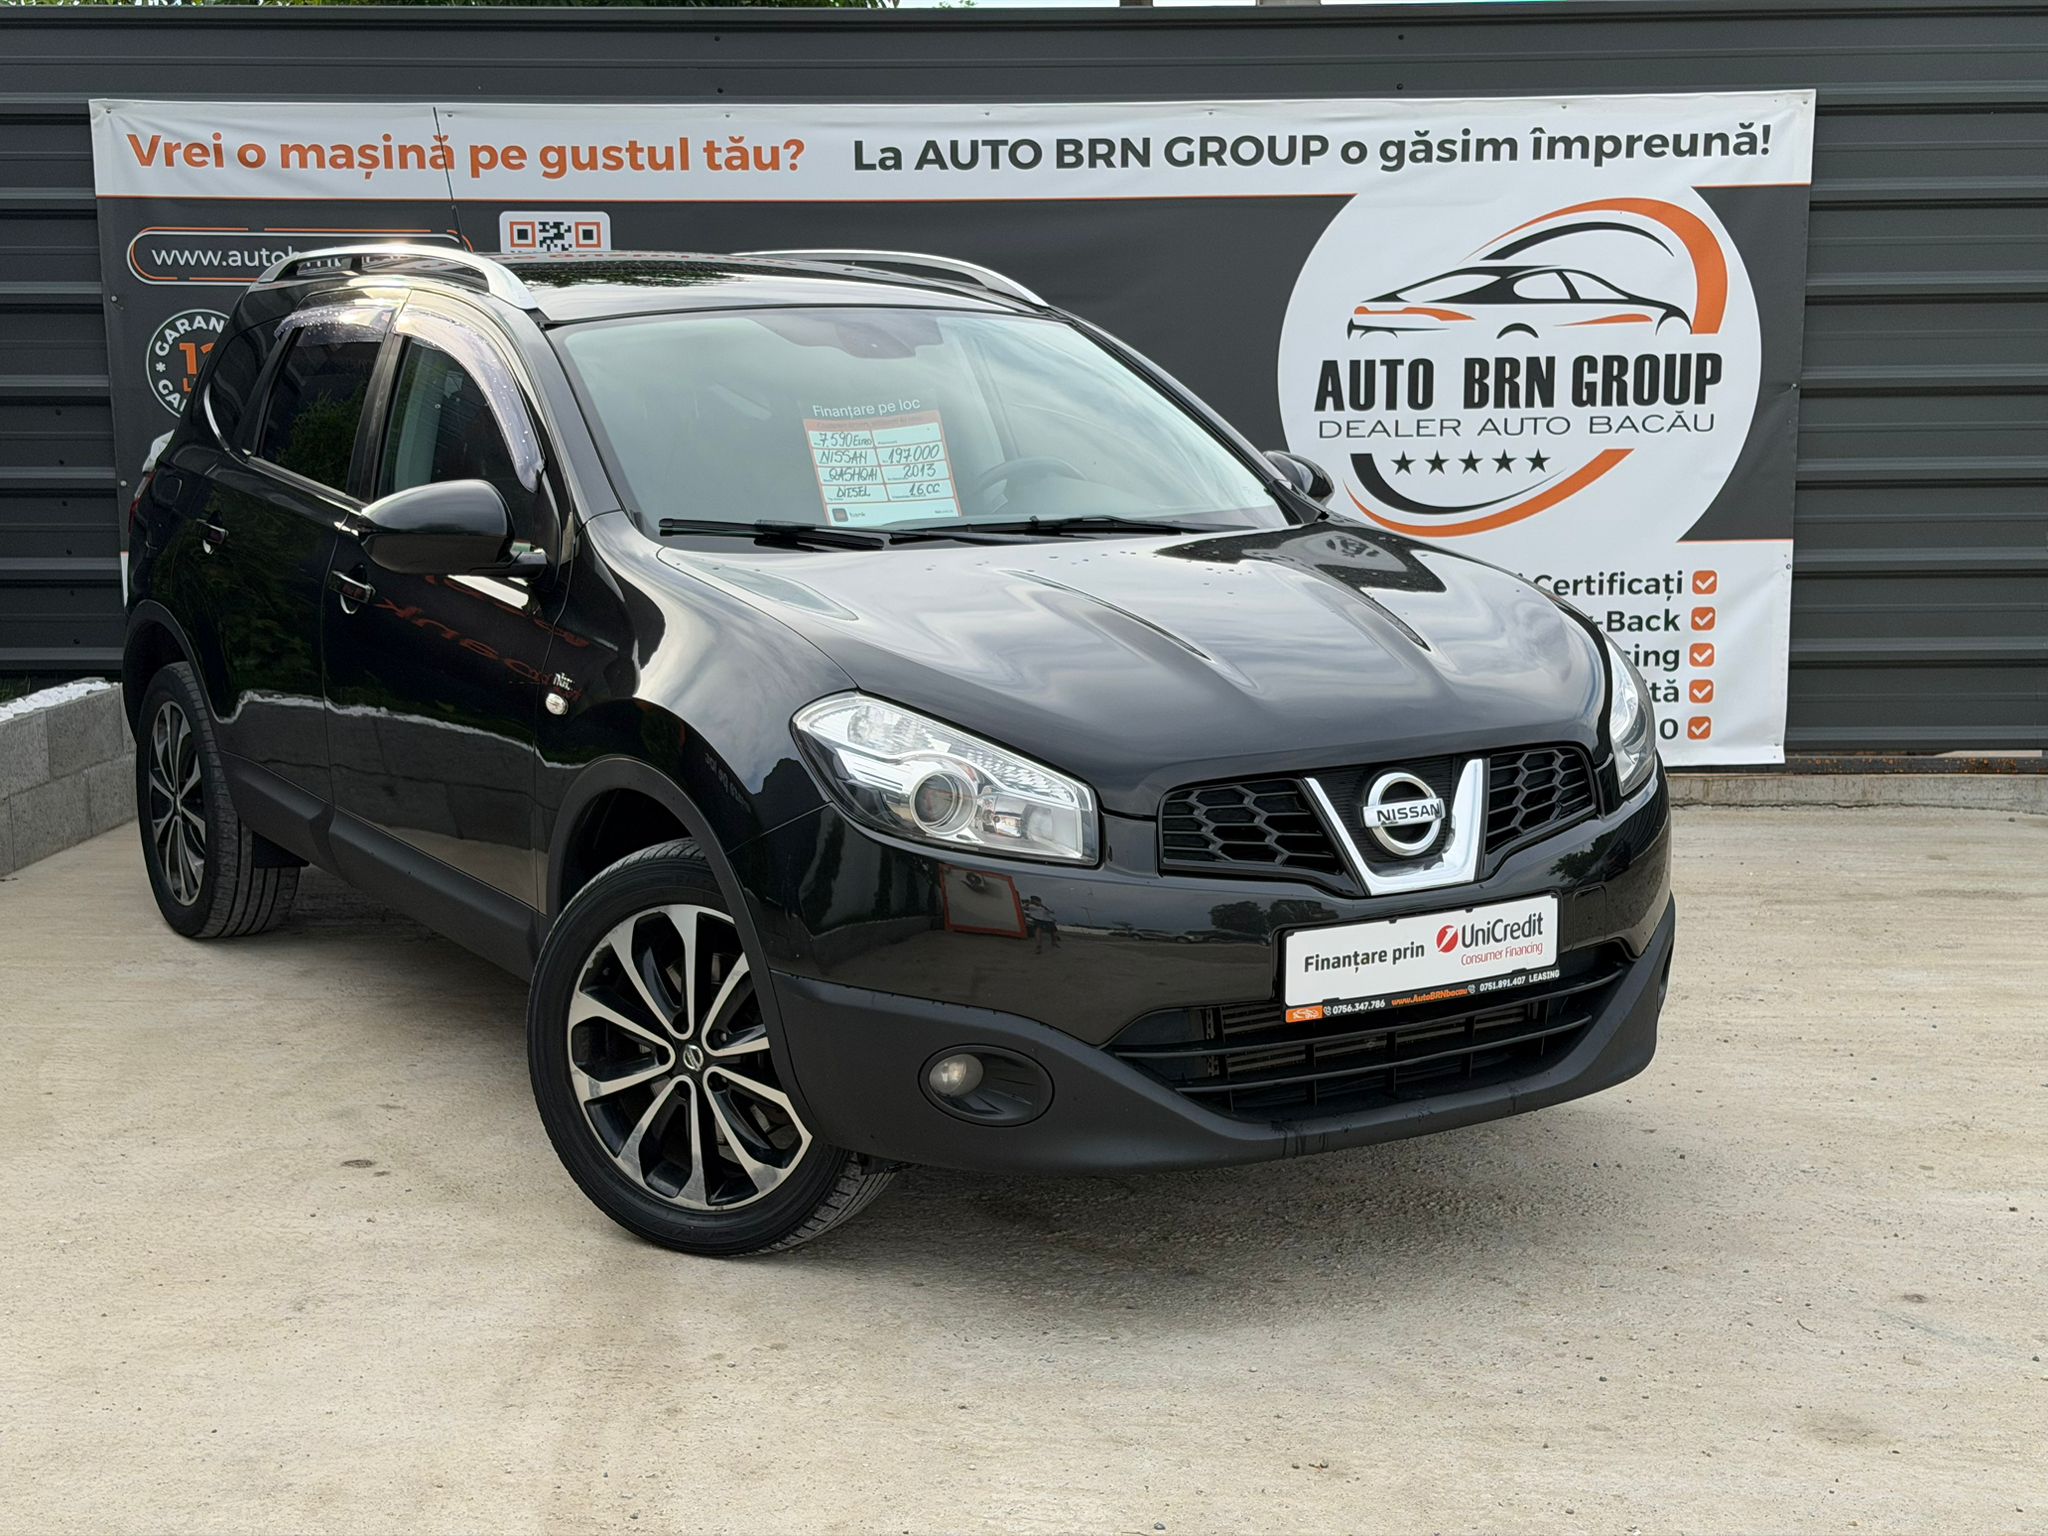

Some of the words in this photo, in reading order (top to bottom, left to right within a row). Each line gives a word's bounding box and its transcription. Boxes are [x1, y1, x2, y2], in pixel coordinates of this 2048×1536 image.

[127, 132, 224, 167] Vrei
[237, 142, 266, 168] o
[280, 133, 455, 179] mașină
[470, 144, 527, 178] pe
[540, 137, 688, 179] gustul
[703, 135, 805, 171] tău?
[854, 140, 902, 170] La
[914, 138, 1043, 170] AUTO
[1056, 137, 1150, 169] BRN
[1164, 135, 1329, 167] GROUP
[1340, 140, 1368, 164] o
[1379, 128, 1518, 171] găsim
[1530, 122, 1771, 167] împreună!
[1314, 358, 1434, 411] AUTO
[1463, 356, 1555, 409] BRN
[1572, 353, 1723, 408] GROUP
[879, 402, 896, 415] pe
[899, 399, 920, 410] loc
[1320, 418, 1461, 438] DEALER
[1477, 416, 1571, 436] AUTO
[1590, 410, 1714, 434] BACĂU
[820, 449, 867, 464] NISSAN
[904, 463, 936, 478] 2013
[1376, 802, 1440, 822] NISSAN
[1461, 911, 1543, 948] UniCredit
[1304, 950, 1387, 974] Finanțare
[1392, 941, 1425, 965] prin
[1461, 950, 1503, 966] Consumer
[1504, 942, 1543, 959] Financing
[1332, 999, 1386, 1015] 0756.347.786
[1528, 970, 1560, 983] LEASING
